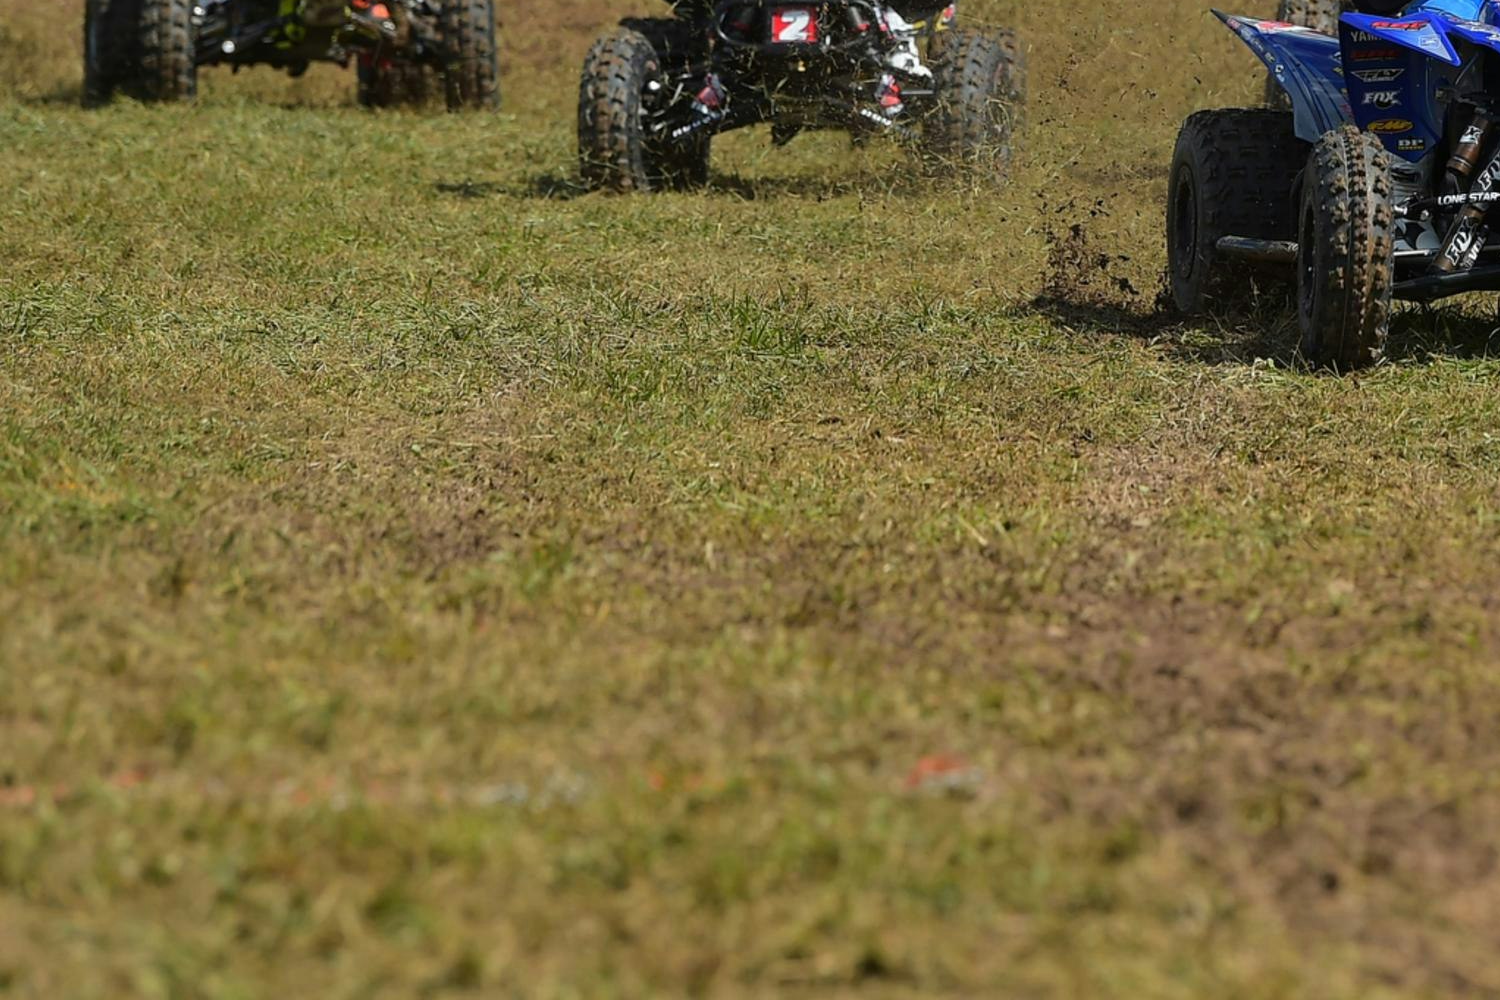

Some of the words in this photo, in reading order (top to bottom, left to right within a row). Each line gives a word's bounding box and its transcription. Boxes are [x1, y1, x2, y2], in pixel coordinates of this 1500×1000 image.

[779, 10, 810, 41] 2
[1363, 91, 1400, 105] FOX
[1438, 194, 1467, 206] LONE
[1445, 215, 1474, 266] FOX
